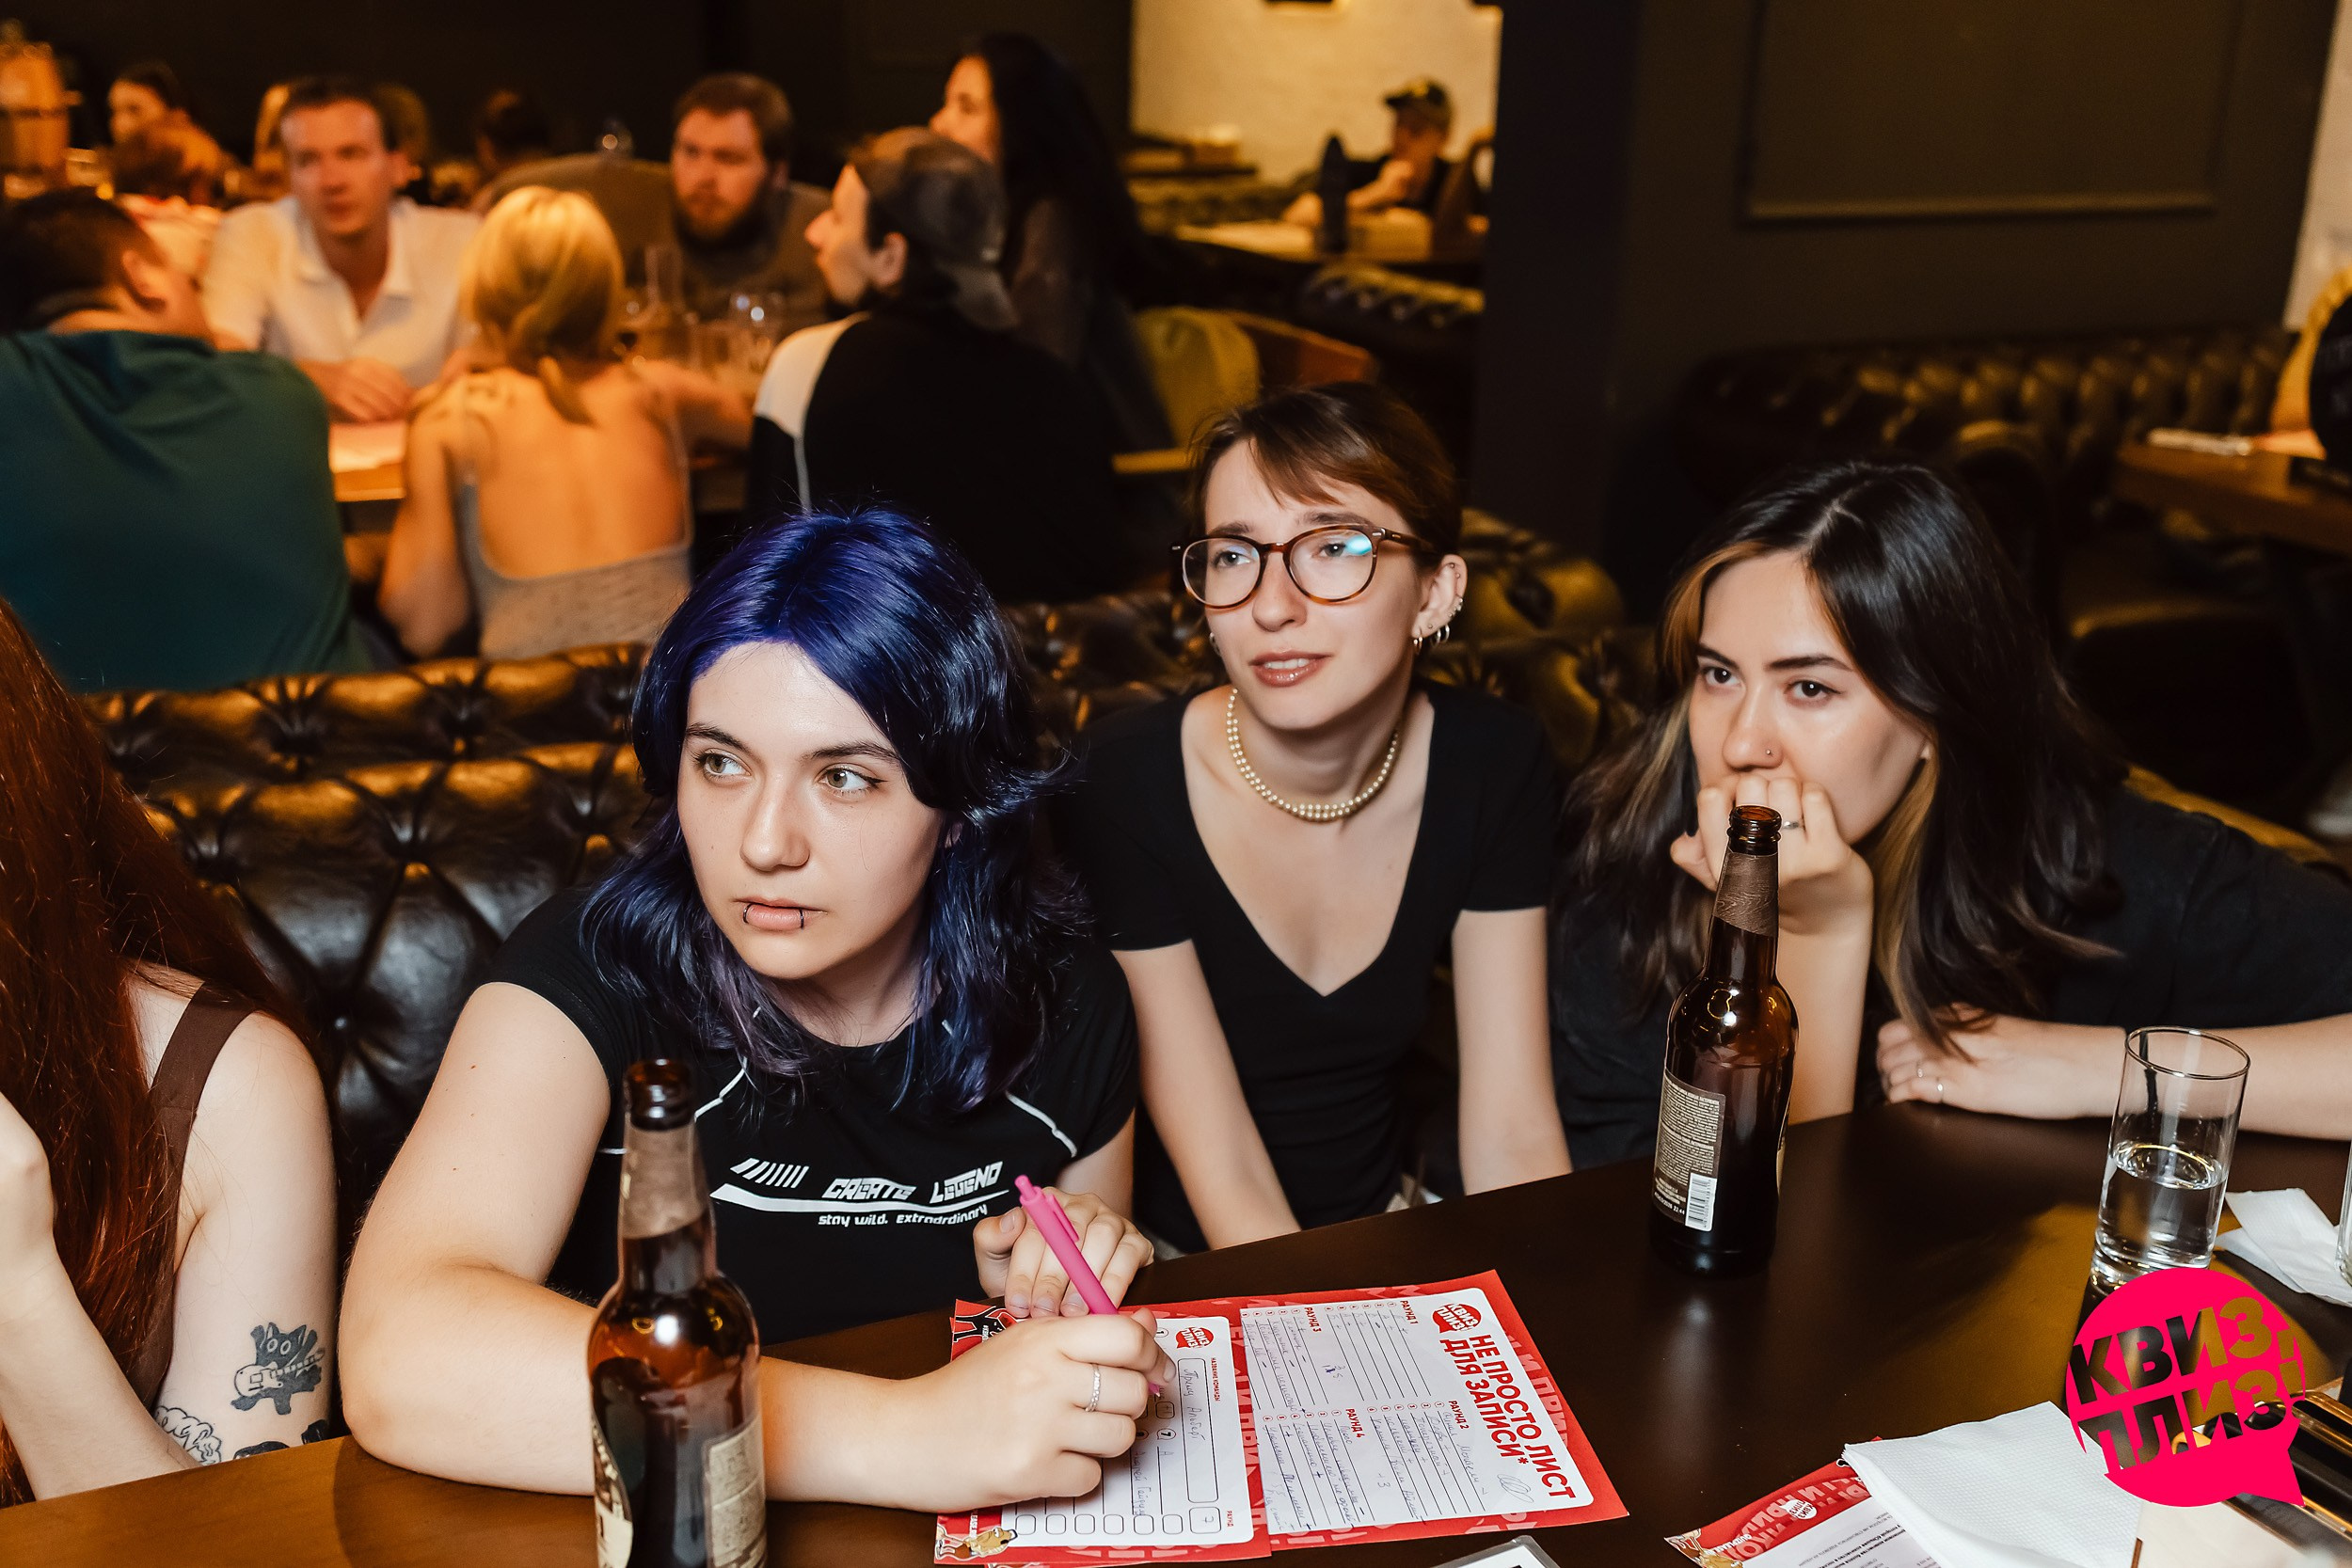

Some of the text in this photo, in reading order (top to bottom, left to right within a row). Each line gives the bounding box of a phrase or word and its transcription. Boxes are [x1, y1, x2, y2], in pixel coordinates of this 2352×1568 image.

[818, 1212, 850, 1227] stay
[854, 1213, 888, 1226] wild.
[1304, 1307, 1318, 1326] РАУНД
[1399, 1300, 1416, 1320] РАУНД
[1439, 1338, 1483, 1375] ДЛЯ
[1469, 1335, 1501, 1358] НЕ
[1212, 1379, 1220, 1401] КОМАНДЫ
[1483, 1361, 1543, 1439] ПРОСТО
[1344, 1408, 1362, 1432] РАУНД
[1448, 1400, 1466, 1423] РАУНД
[1524, 1443, 1575, 1497] ЛИСТ
